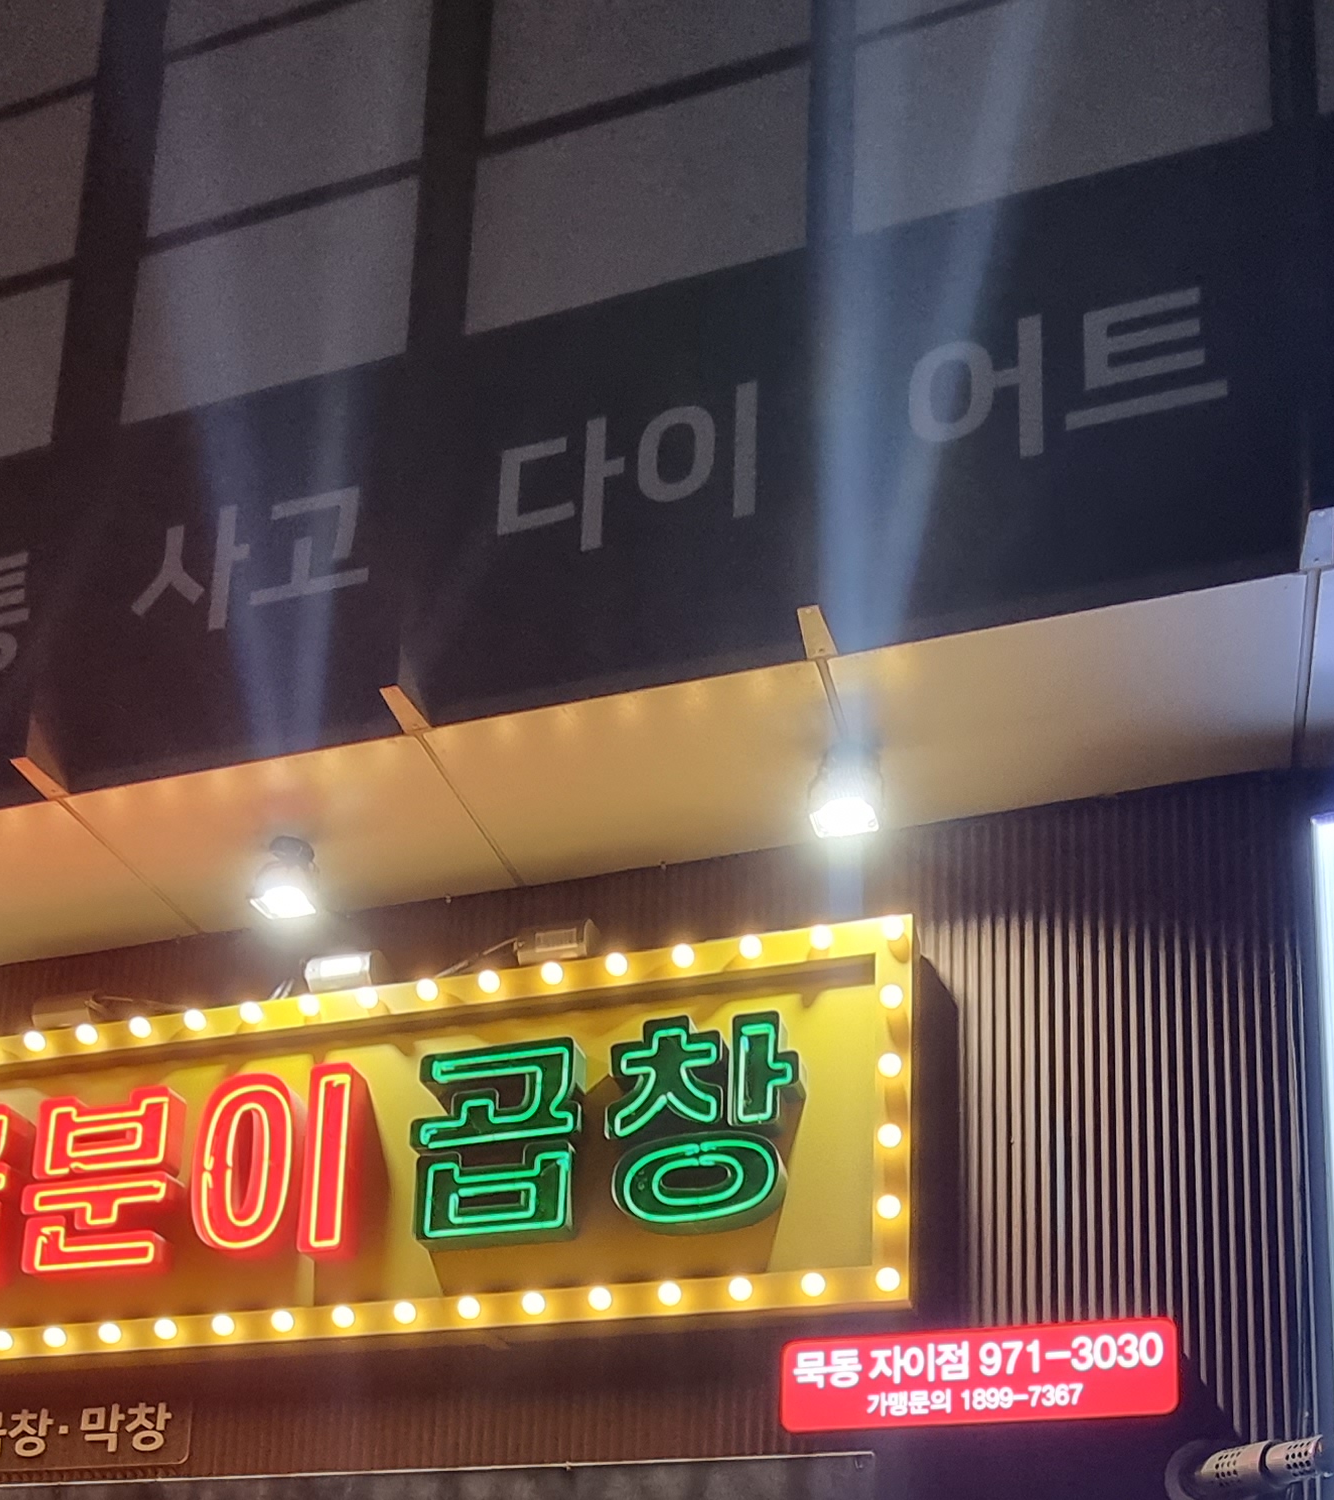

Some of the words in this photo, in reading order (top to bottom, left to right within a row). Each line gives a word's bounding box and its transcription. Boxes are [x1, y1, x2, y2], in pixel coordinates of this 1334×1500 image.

[130, 484, 370, 633] 사고
[495, 380, 759, 553] 다이
[907, 286, 1229, 459] 어트
[411, 1010, 807, 1247] 곱창
[792, 1347, 863, 1389] 묵동
[868, 1340, 970, 1385] 자이점
[977, 1331, 1165, 1377] 971-3030
[866, 1388, 952, 1418] 가맹문의
[961, 1382, 1084, 1412] 1899-7367
